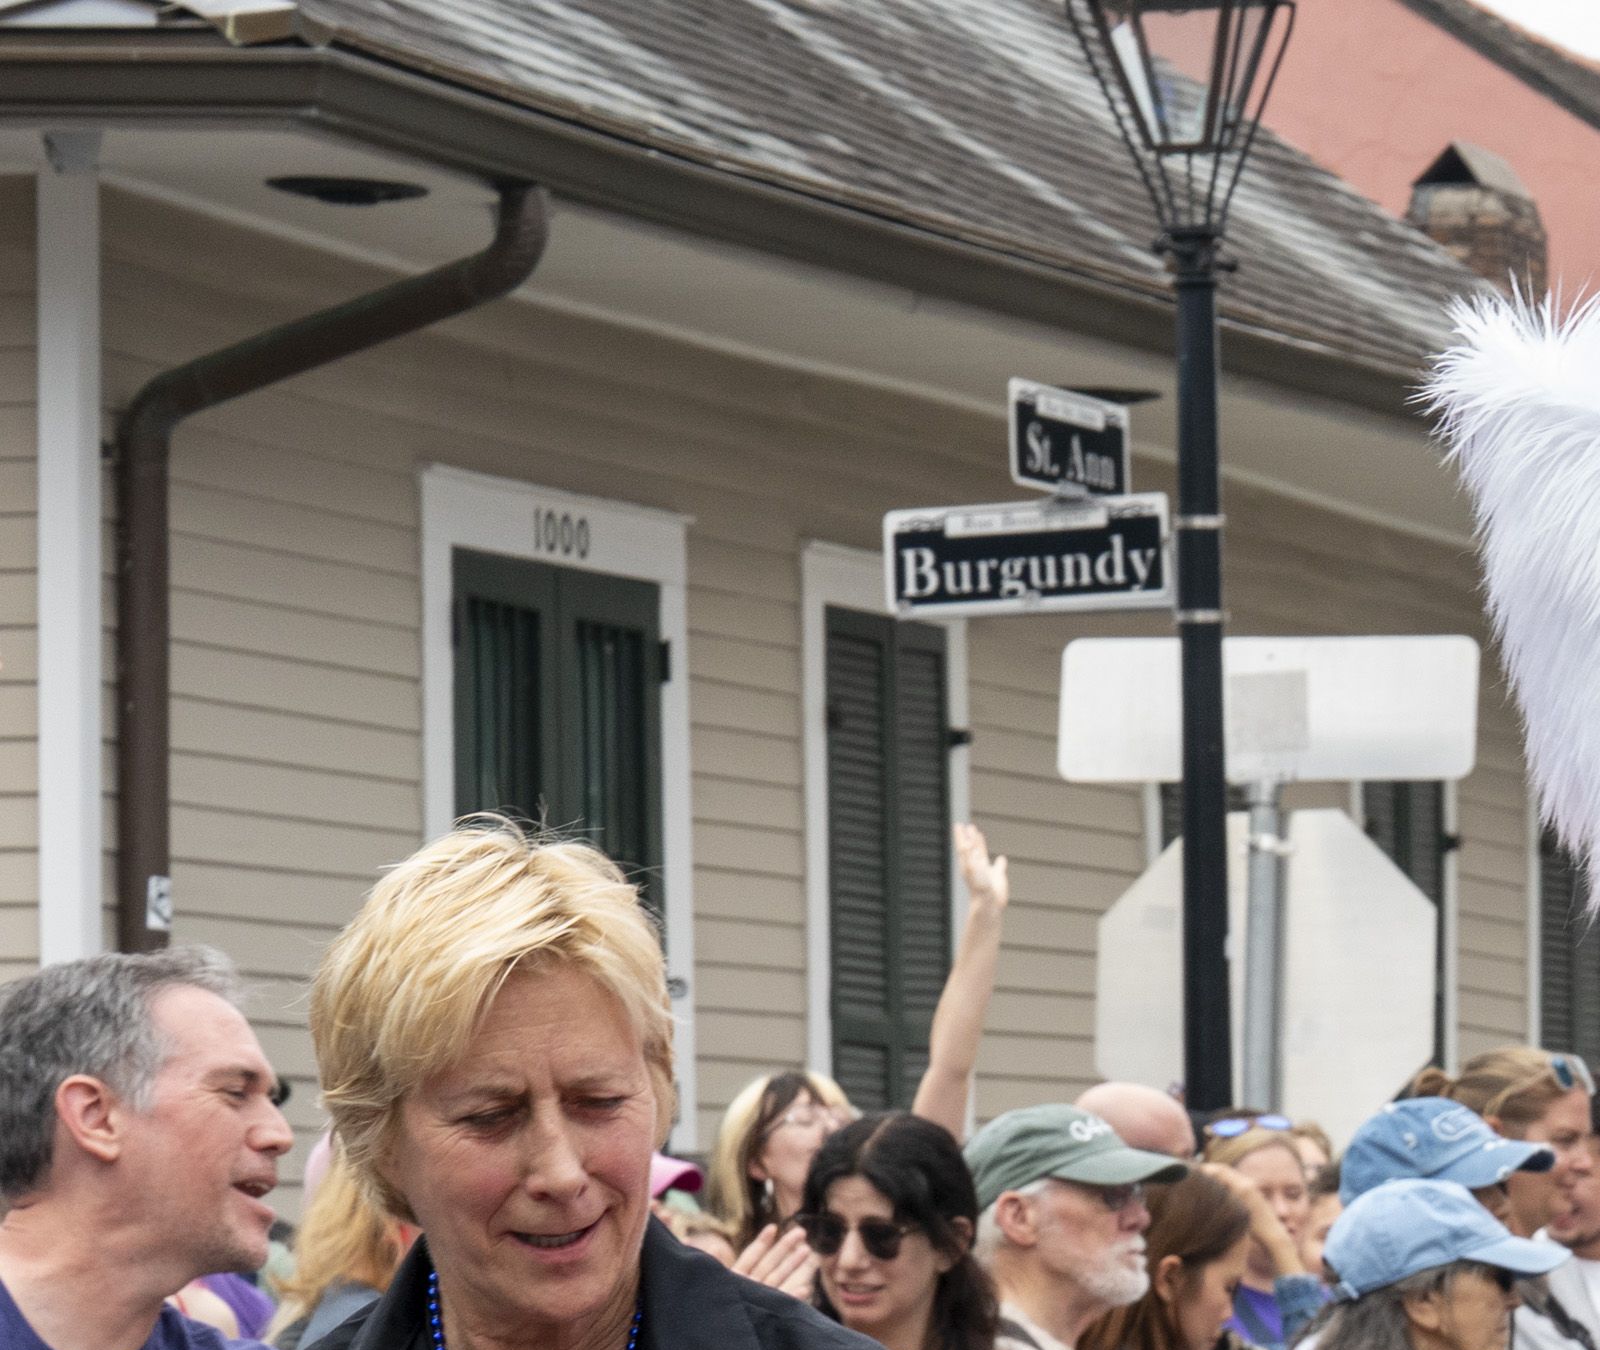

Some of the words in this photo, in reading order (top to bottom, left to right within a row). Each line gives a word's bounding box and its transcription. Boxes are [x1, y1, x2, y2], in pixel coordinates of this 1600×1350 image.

[1026, 421, 1060, 476] St.
[1065, 433, 1116, 490] Ann
[533, 506, 591, 559] 1000
[901, 532, 1156, 600] Burgundy
